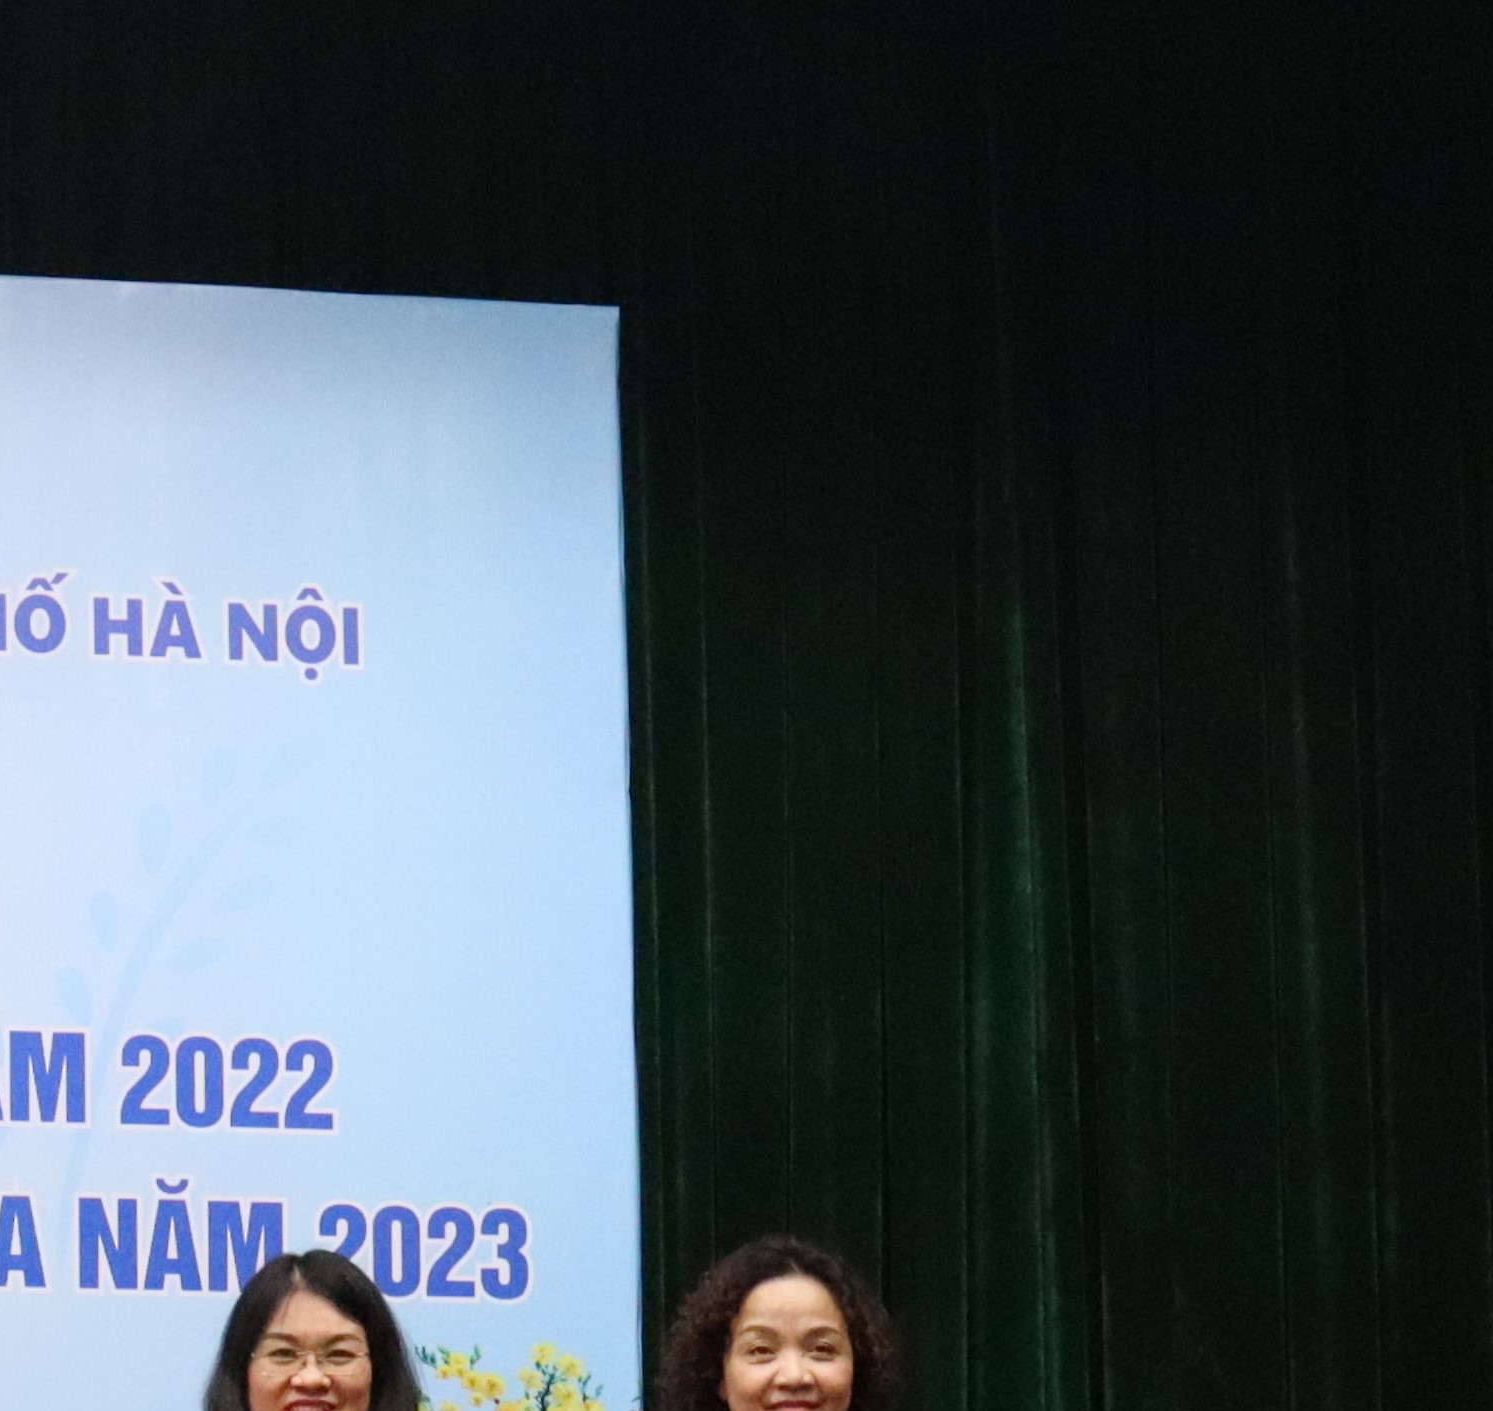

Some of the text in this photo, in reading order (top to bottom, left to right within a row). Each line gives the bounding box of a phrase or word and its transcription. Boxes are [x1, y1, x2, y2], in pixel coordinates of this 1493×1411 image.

[92, 583, 202, 659] HÀ
[228, 588, 360, 680] NỘI
[122, 1034, 335, 1131] 2022
[79, 1180, 284, 1291] NĂM
[318, 1205, 529, 1301] 2023
